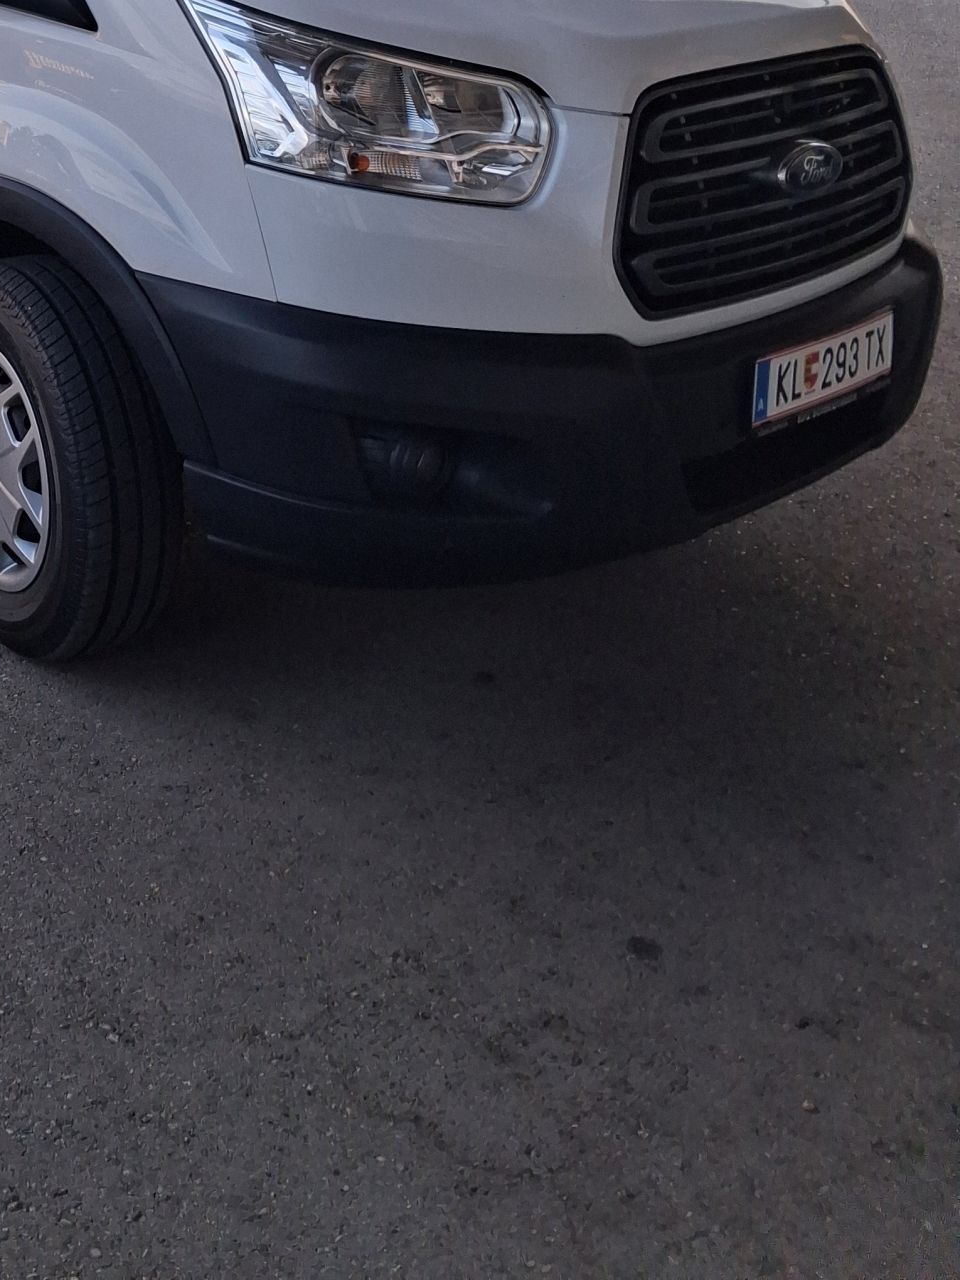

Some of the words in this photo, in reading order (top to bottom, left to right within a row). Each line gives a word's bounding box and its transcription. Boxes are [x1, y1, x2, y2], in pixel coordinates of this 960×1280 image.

[776, 359, 801, 407] KL
[821, 337, 859, 390] 293
[865, 324, 887, 370] TX
